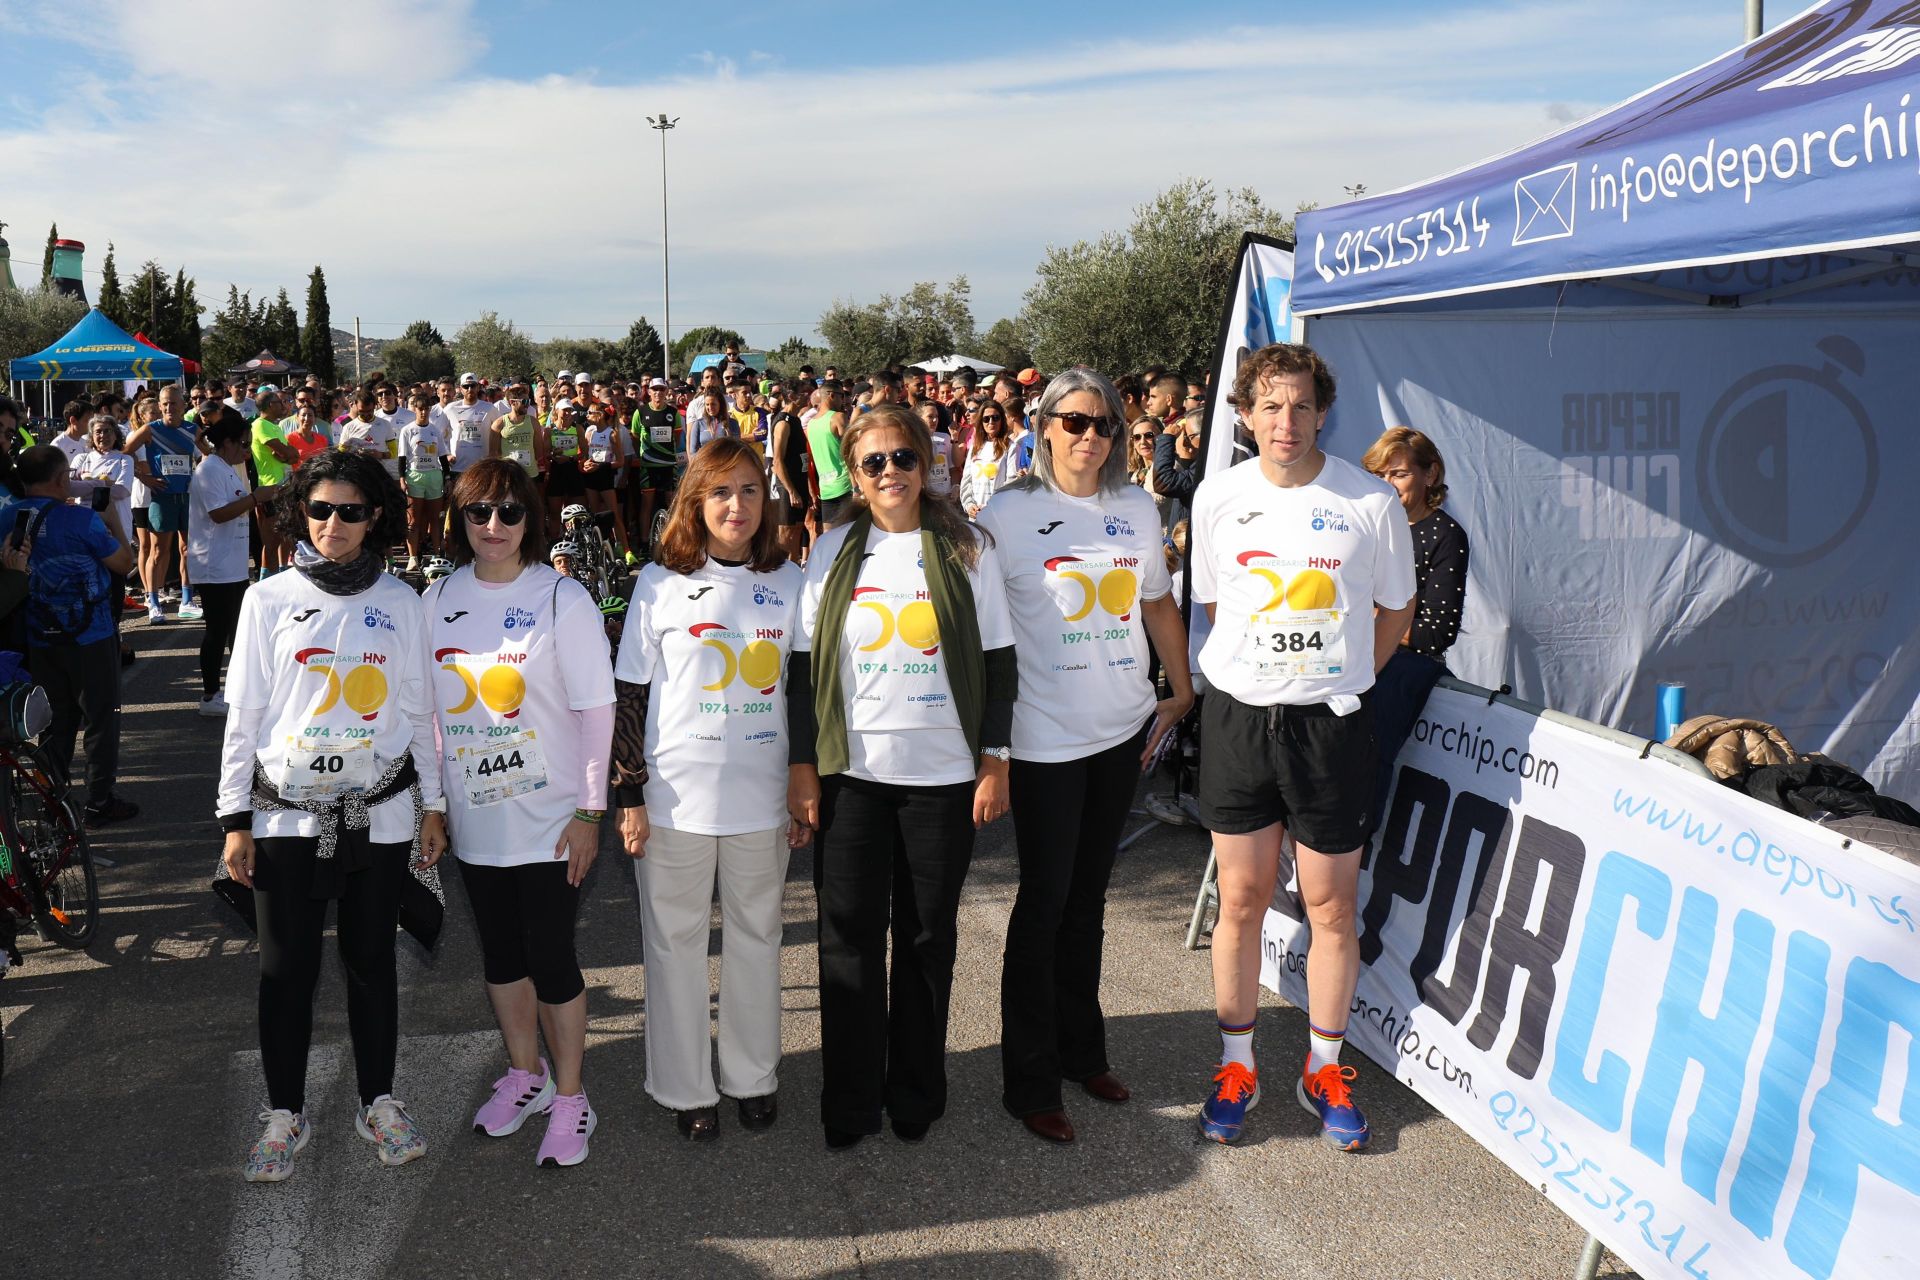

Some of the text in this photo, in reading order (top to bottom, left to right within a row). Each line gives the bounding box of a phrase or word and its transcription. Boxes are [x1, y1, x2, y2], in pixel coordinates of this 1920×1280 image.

[1589, 93, 1920, 223] info@deporchi
[1335, 195, 1490, 277] 925257314
[1060, 557, 1139, 570] ANIVERSARIO HNP
[1308, 556, 1341, 570] HNP
[704, 629, 784, 640] ANIVERSARIO HNP
[1061, 632, 1091, 645] 1974
[1271, 631, 1323, 653] 384
[310, 655, 361, 664] ANIVERSARIO
[497, 653, 527, 664] HNP
[858, 663, 888, 674] 1974
[903, 663, 937, 674] 2024
[699, 702, 730, 715] 1974
[743, 702, 772, 714] 2024
[445, 725, 474, 735] 1974
[487, 725, 520, 737] 2024
[1410, 718, 1559, 789] orchip.com
[309, 755, 344, 773] 40
[477, 750, 524, 777] 444
